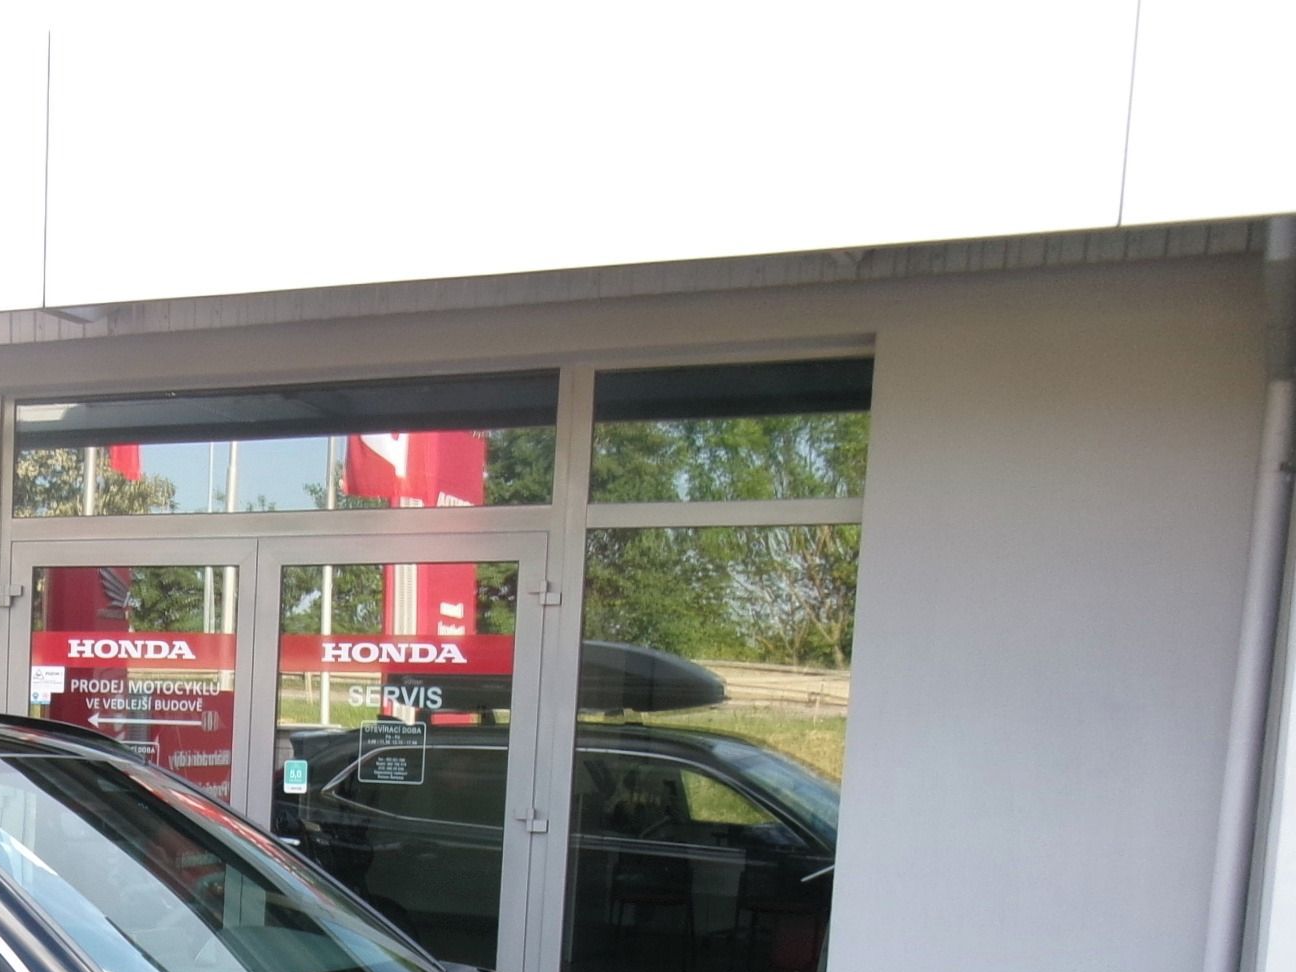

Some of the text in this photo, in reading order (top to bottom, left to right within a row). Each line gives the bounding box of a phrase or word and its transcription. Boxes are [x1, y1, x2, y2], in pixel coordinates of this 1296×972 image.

[68, 639, 196, 660] HONDA
[321, 642, 467, 663] HONDA
[70, 679, 124, 694] PRODEJ
[128, 677, 220, 697] MOTOCYKLŮ
[348, 685, 443, 709] SERVIS
[86, 696, 203, 712] VE VEDLEJŠÍ BUDOVĚ
[364, 724, 422, 734] OTEVÍRACÍ DOBA
